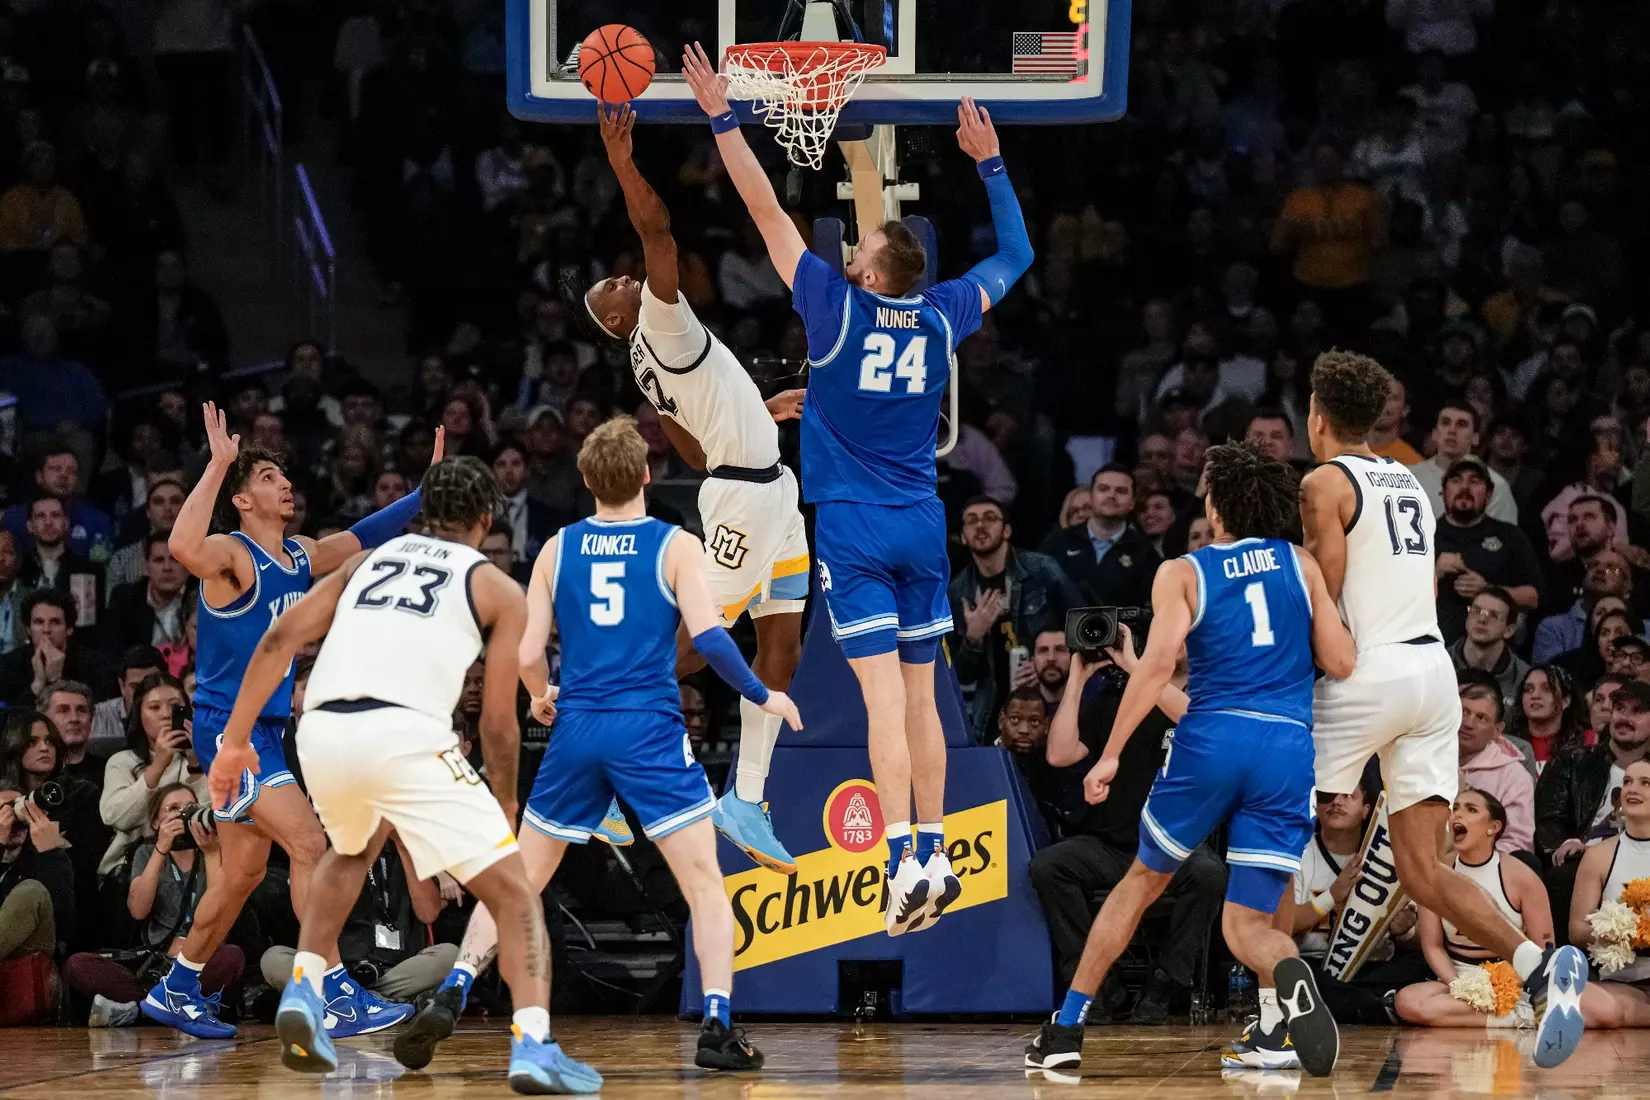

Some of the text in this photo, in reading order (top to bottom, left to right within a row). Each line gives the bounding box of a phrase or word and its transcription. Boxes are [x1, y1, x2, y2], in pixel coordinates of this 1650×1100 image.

[876, 306, 921, 330] NUNGE
[858, 332, 928, 395] 24
[396, 542, 453, 559] JOPLIN
[580, 533, 638, 556] KUNKEL
[710, 524, 749, 570] MU
[1383, 494, 1429, 556] 13
[353, 556, 454, 619] 23
[589, 561, 626, 627] 5
[1223, 547, 1281, 579] CLAUDE
[1243, 580, 1276, 648] 1
[843, 830, 873, 844] 1783
[731, 830, 993, 958] Schwees
[1325, 824, 1401, 979] ING OUT
